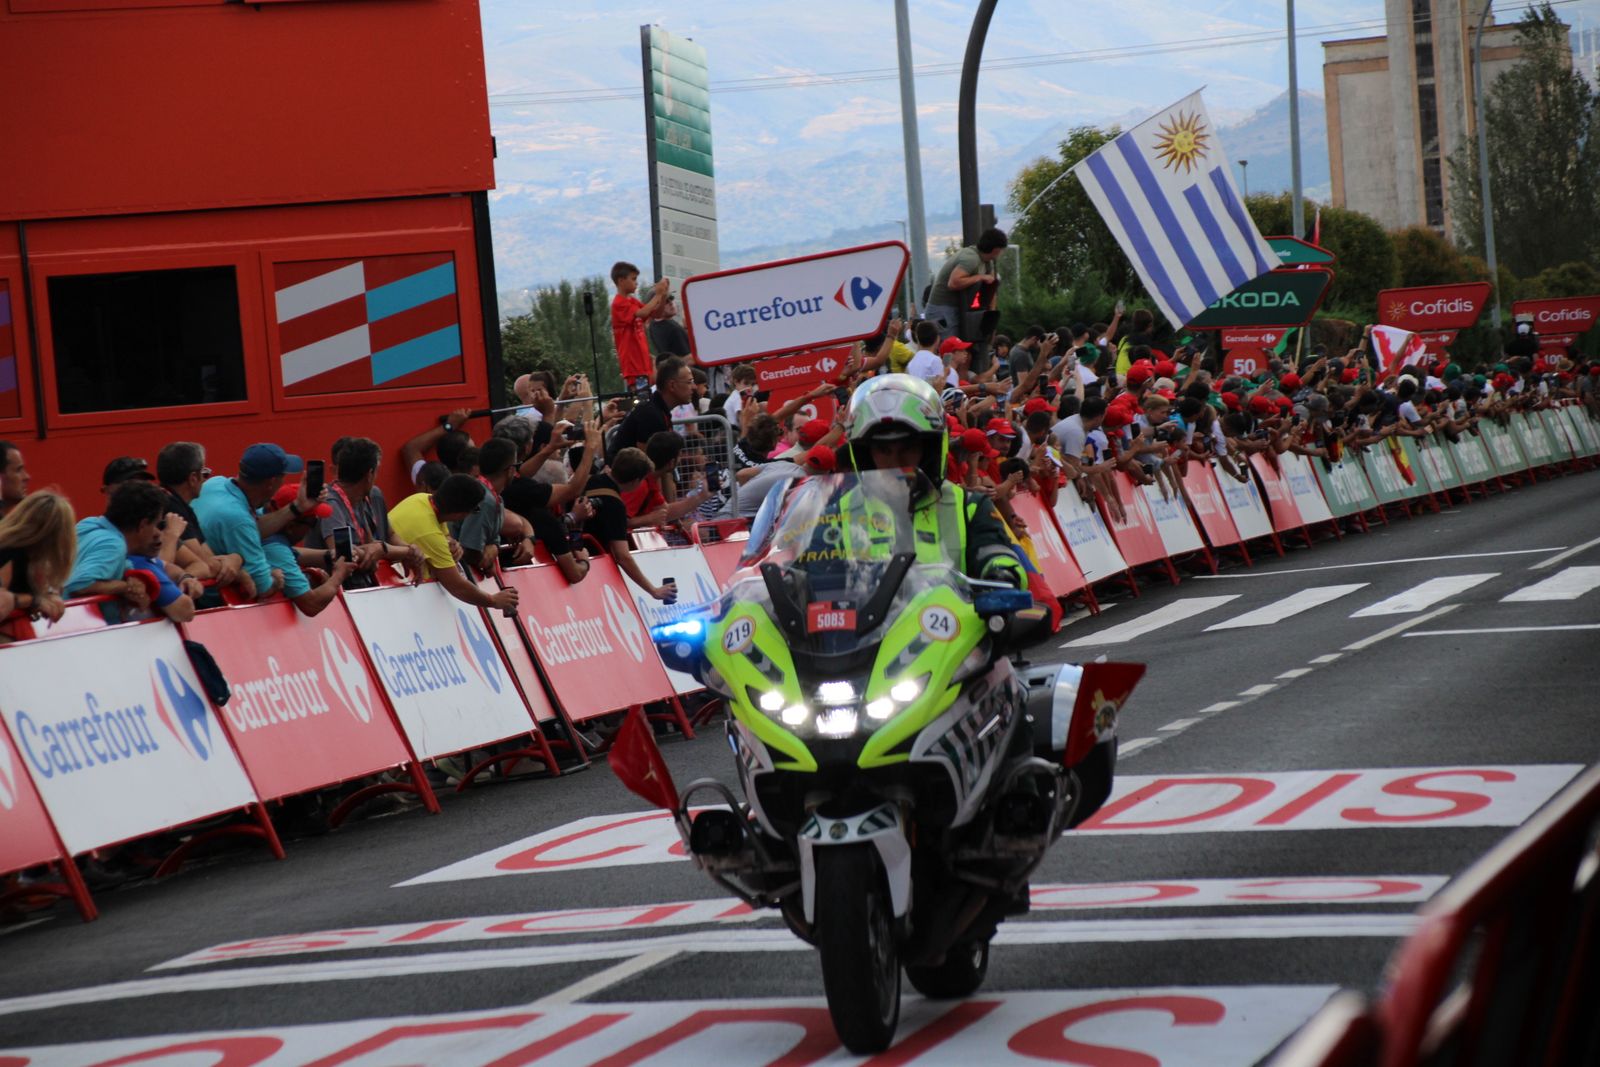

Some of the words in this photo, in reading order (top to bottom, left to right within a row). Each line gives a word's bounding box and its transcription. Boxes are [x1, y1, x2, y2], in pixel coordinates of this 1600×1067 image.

[1209, 291, 1300, 308] KODA
[1410, 298, 1474, 316] Cofidis
[704, 296, 823, 331] Carrefour
[1538, 308, 1591, 322] Cofidis
[760, 365, 812, 380] Carrefour
[1233, 358, 1256, 375] 50
[817, 612, 845, 628] 5083
[929, 615, 950, 632] 24
[527, 605, 613, 666] Carrefour
[726, 621, 750, 649] 219
[372, 632, 468, 698] Carrefour
[15, 692, 159, 779] Carrefour
